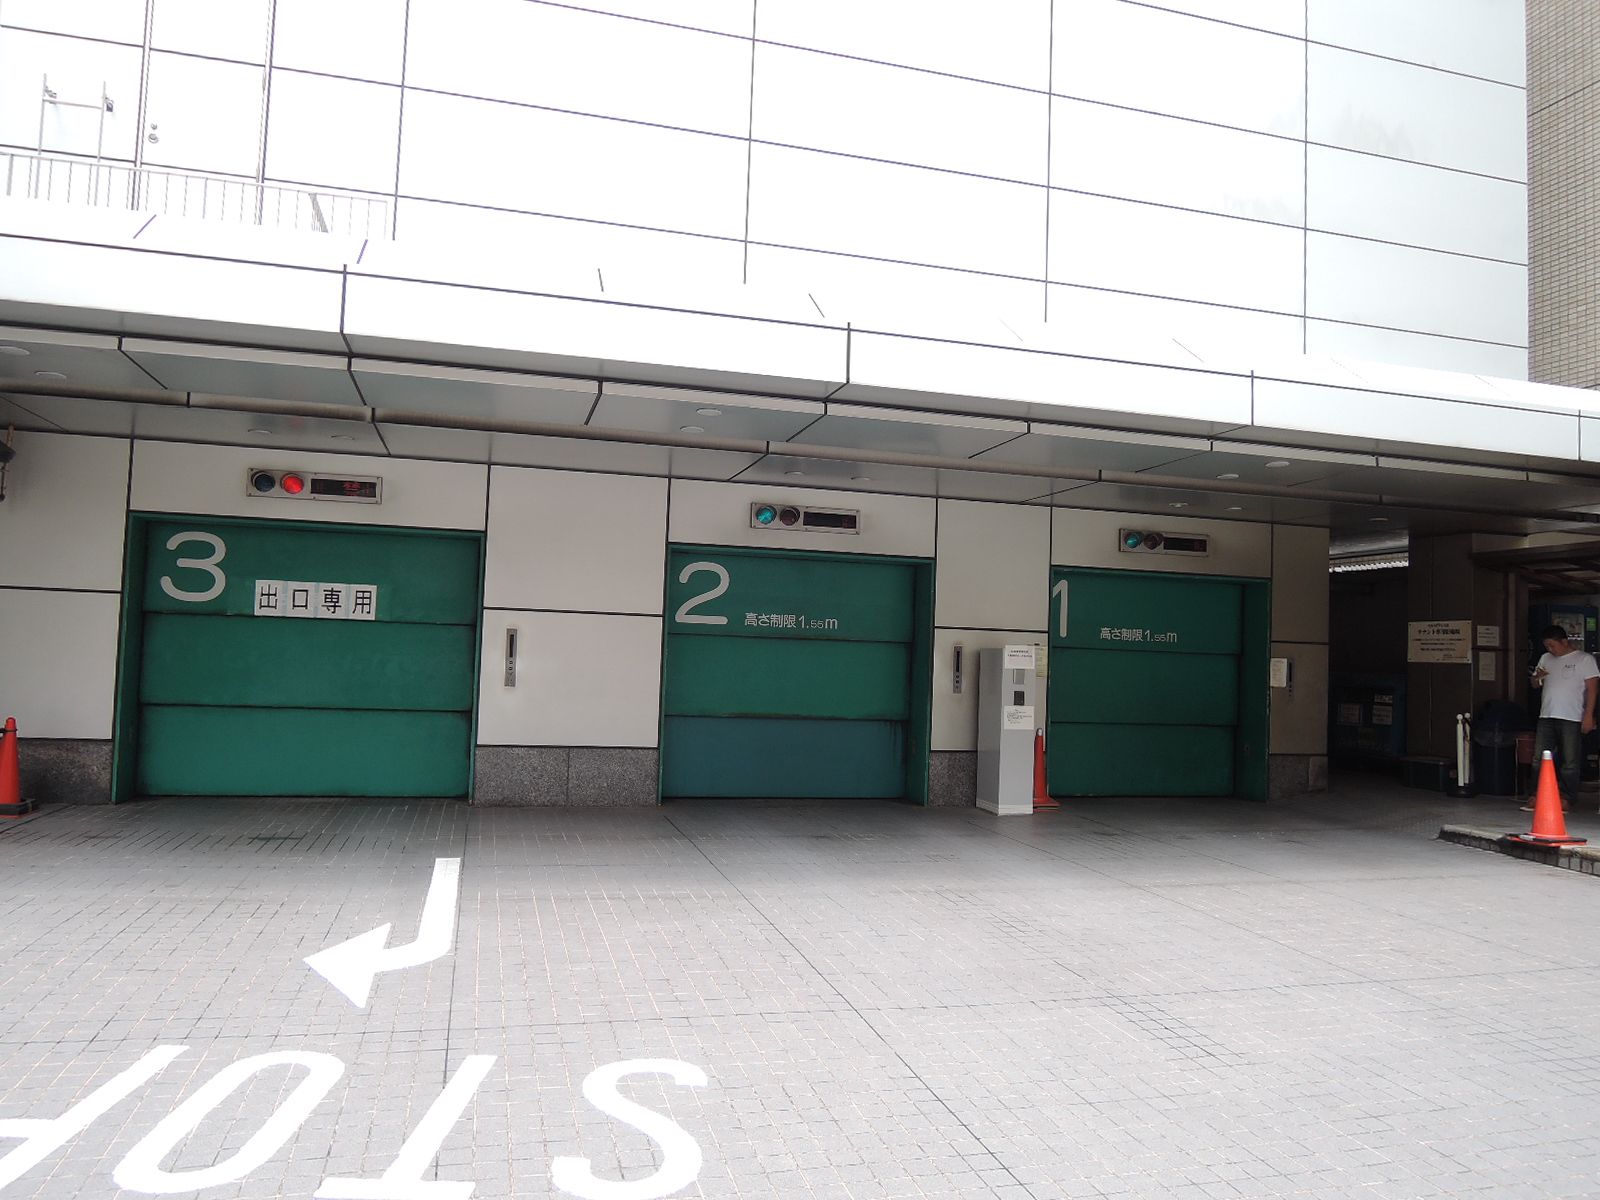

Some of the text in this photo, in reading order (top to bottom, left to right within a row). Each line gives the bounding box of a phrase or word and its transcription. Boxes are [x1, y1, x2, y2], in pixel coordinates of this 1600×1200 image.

[160, 531, 227, 602] 3
[675, 561, 730, 625] 2
[258, 584, 373, 615] 出口専用
[1052, 579, 1068, 638] 1
